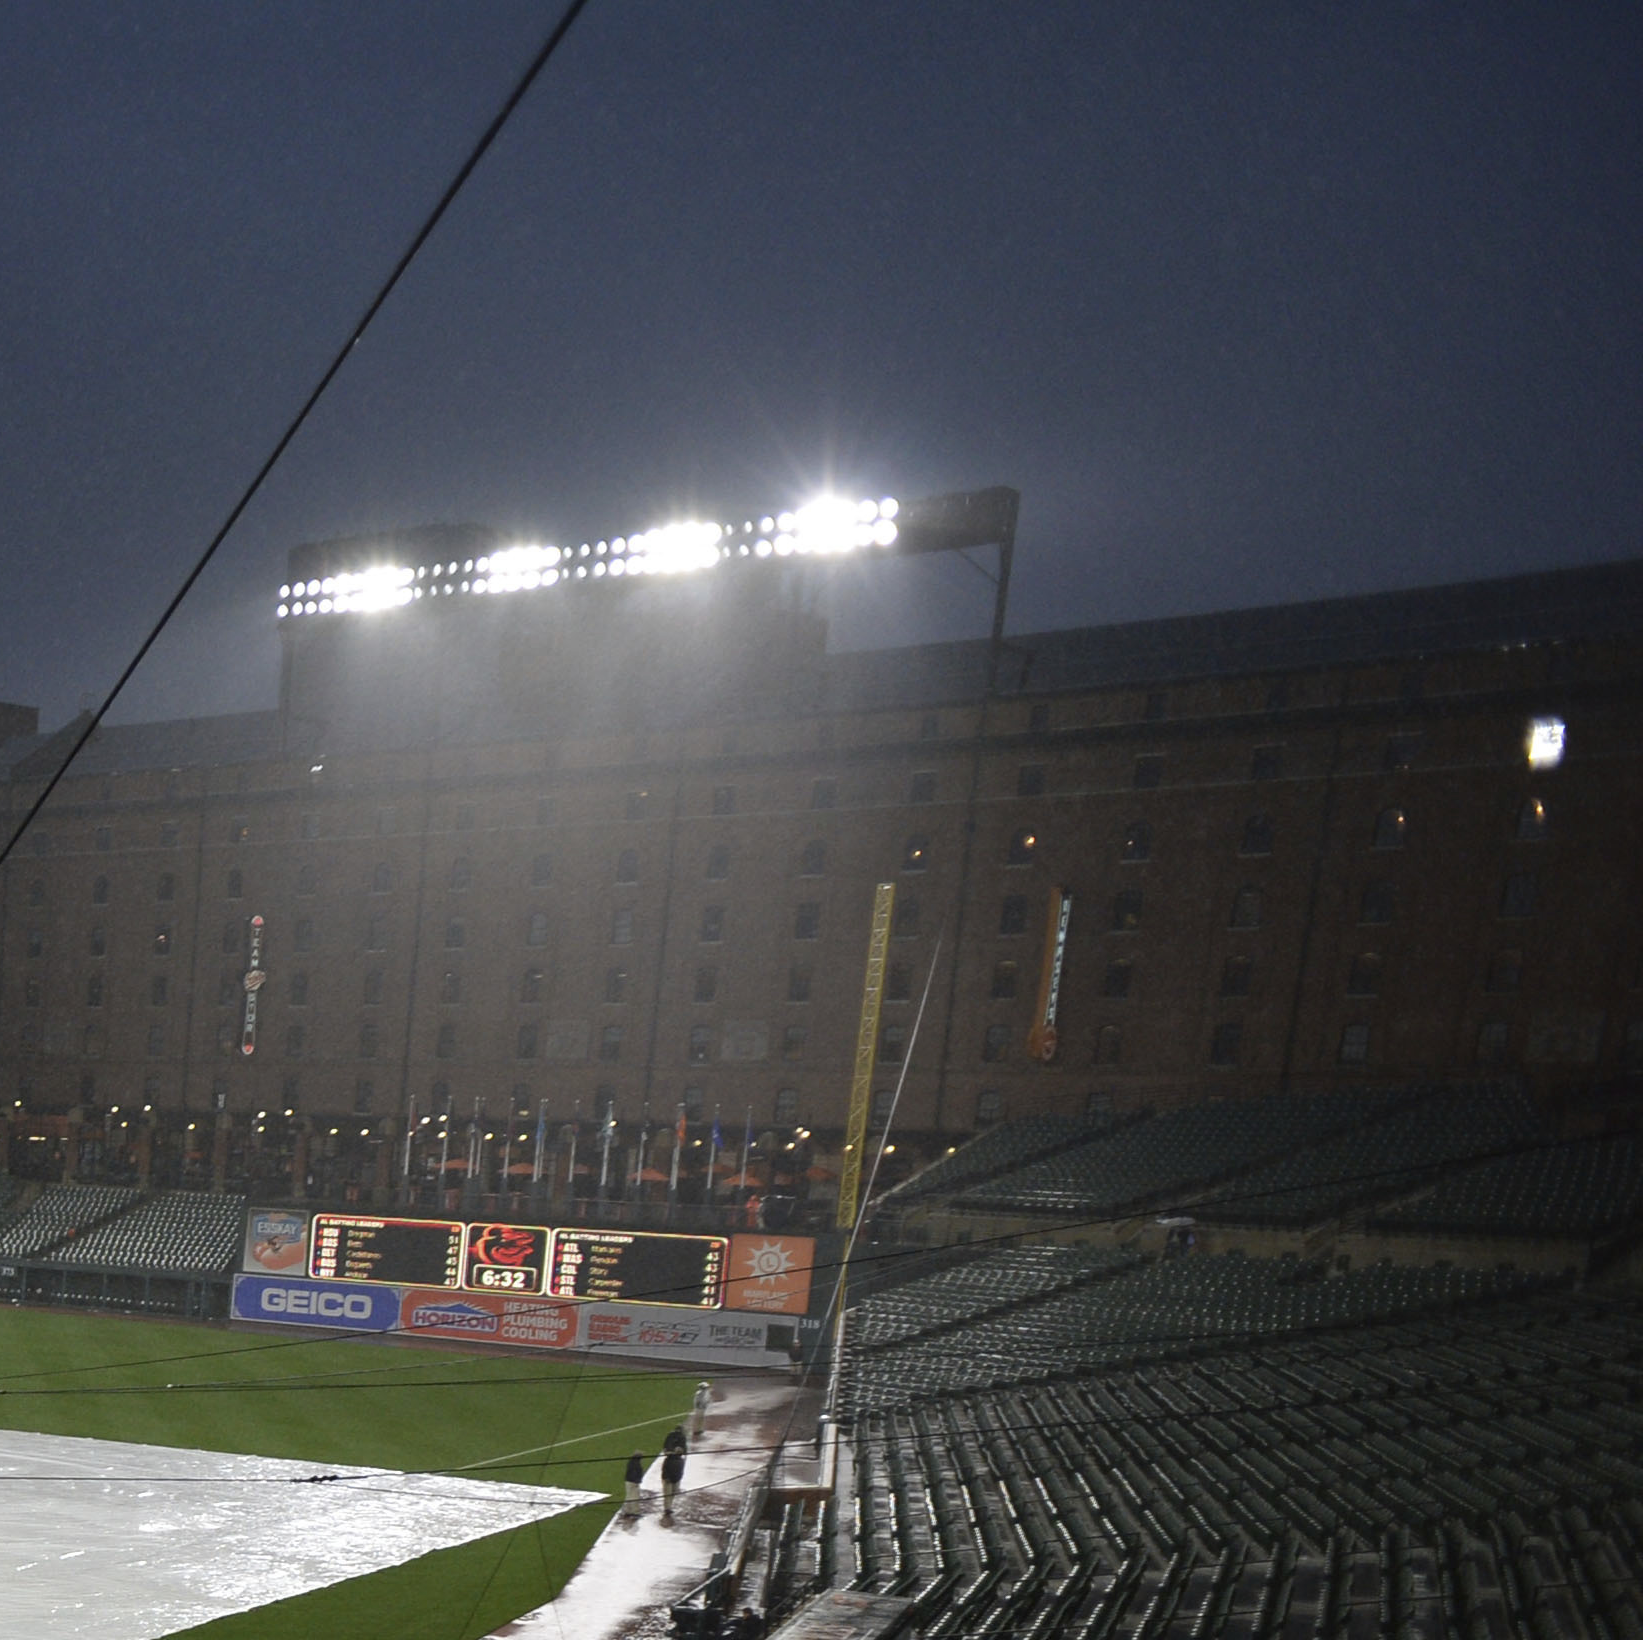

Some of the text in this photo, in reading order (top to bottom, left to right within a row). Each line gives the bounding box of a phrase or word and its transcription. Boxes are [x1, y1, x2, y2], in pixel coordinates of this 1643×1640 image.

[257, 1220, 299, 1236] ESSKAY
[482, 1271, 526, 1288] 6:32
[260, 1287, 373, 1319] GEICO
[503, 1301, 560, 1317] HEATING
[413, 1310, 496, 1332] HORIZON
[502, 1315, 569, 1331] PLUMBING
[800, 1318, 821, 1329] 318
[501, 1325, 558, 1342] COOLING
[709, 1324, 730, 1337] THE
[729, 1326, 762, 1339] TEAM
